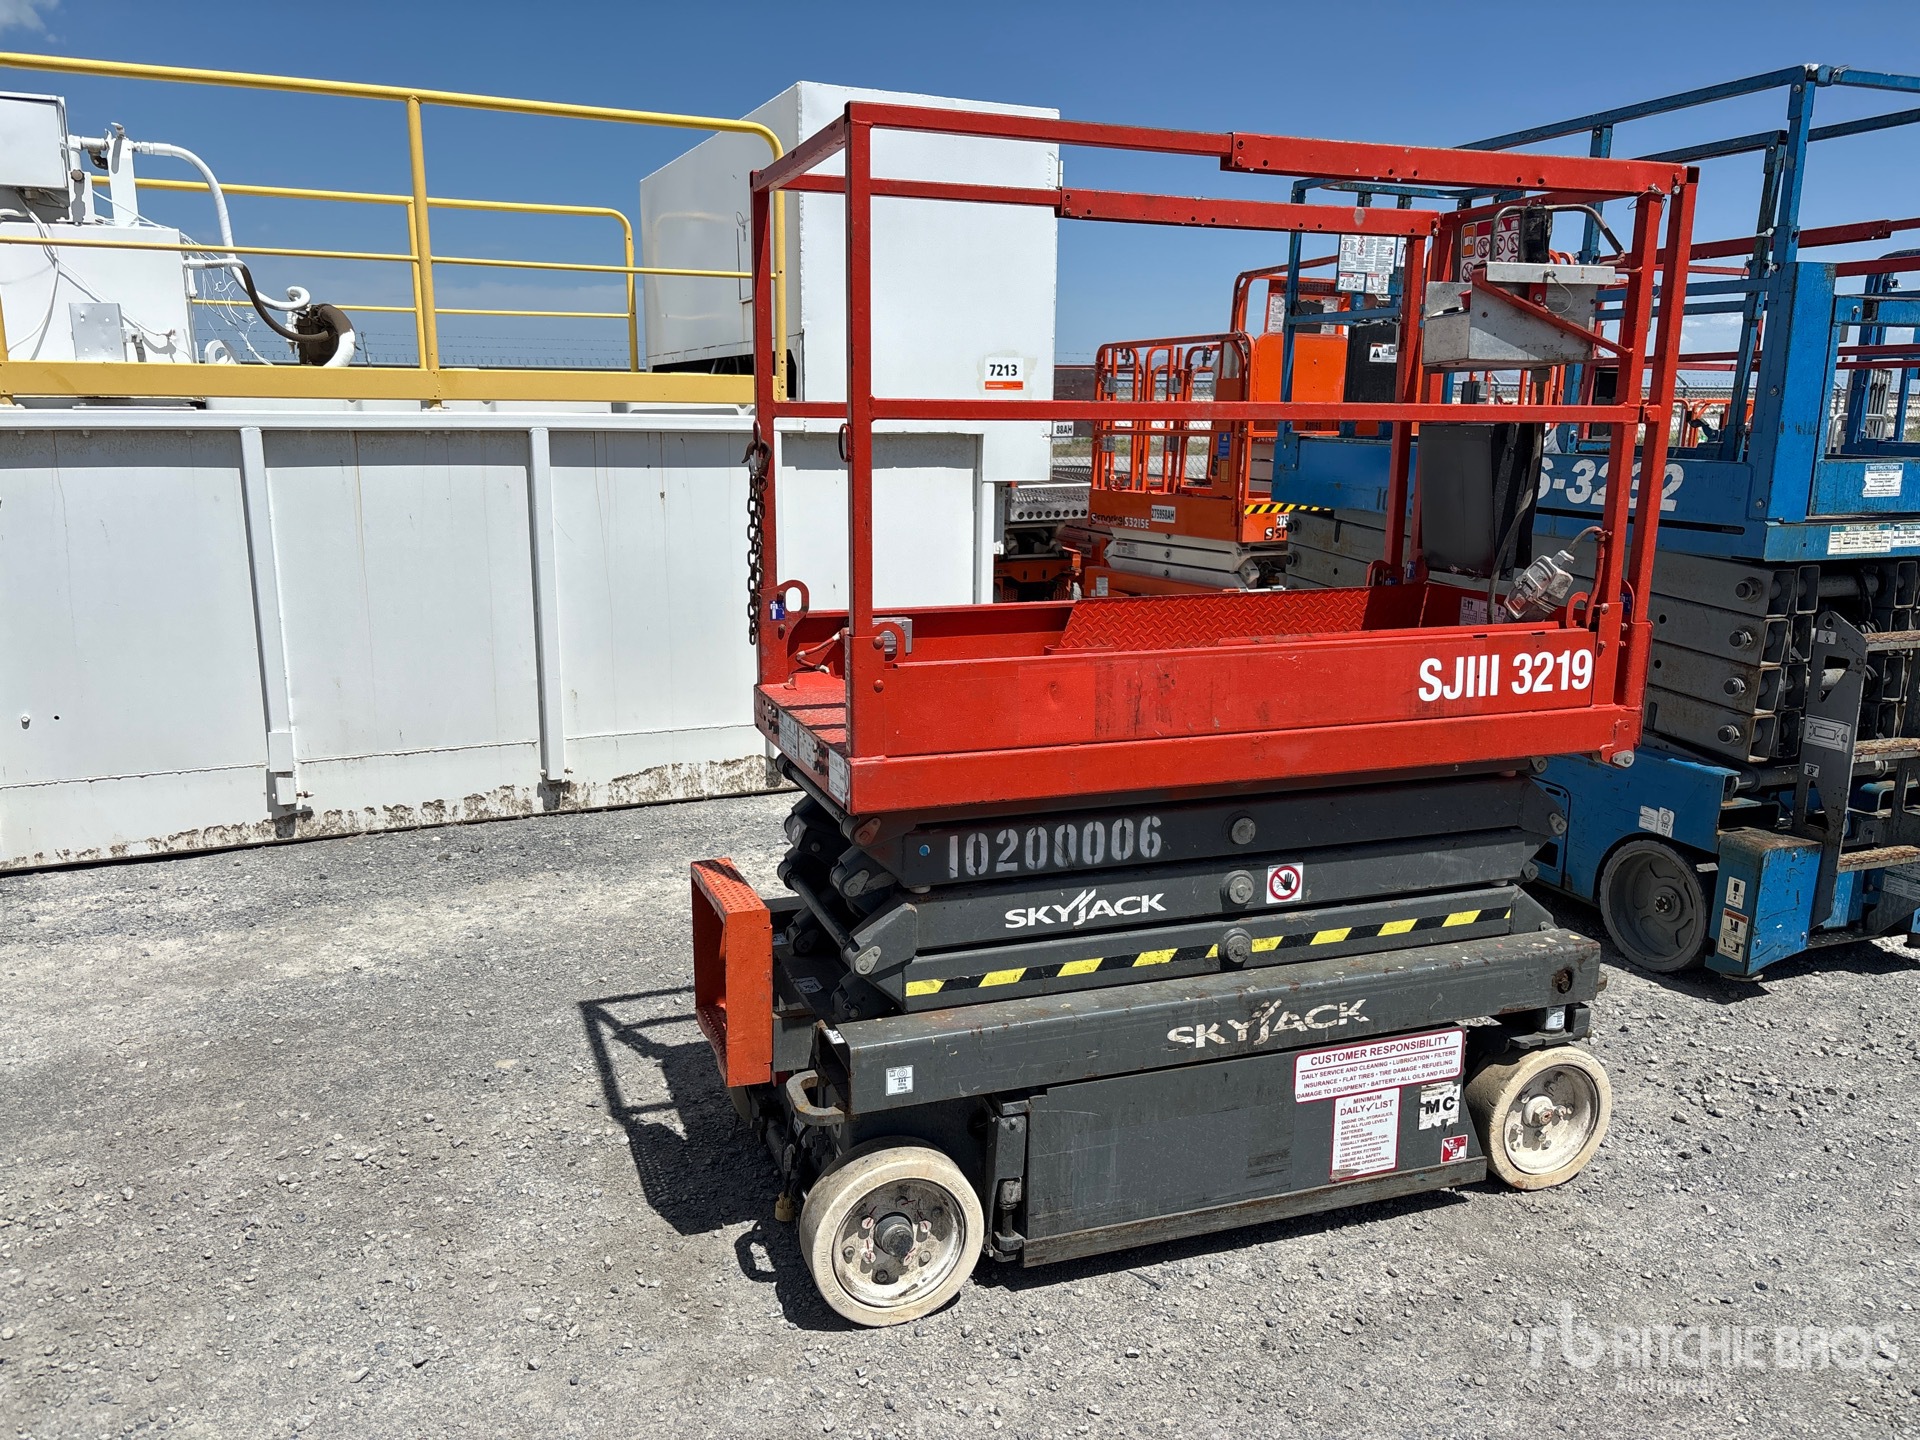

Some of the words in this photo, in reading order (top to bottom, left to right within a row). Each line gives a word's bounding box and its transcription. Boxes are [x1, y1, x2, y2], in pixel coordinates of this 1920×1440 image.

[989, 364, 1018, 377] 7213
[1511, 648, 1593, 695] 3219
[949, 815, 1162, 878] 10200006
[1005, 888, 1167, 929] SKYJACK
[1166, 998, 1371, 1048] SKYJACK
[1302, 1072, 1318, 1080] DAILY
[1320, 1068, 1345, 1078] SERVICE
[1359, 1060, 1388, 1071] CLEANING
[1392, 1053, 1430, 1066] LUBRICATION
[1434, 1050, 1456, 1058] FILTERS
[1310, 1049, 1367, 1066] CUSTOMER
[1370, 1036, 1449, 1056] RESPONSIBILITY
[1296, 1090, 1323, 1099] DAMAGE
[1332, 1083, 1366, 1093] EQUIPMENT
[1370, 1078, 1396, 1086] BATTERY
[1439, 1067, 1458, 1076] FLUIDS
[1304, 1078, 1338, 1089] INSURANCE
[1393, 1066, 1418, 1074] DAMAGE
[1422, 1060, 1453, 1069] REFUELING
[1340, 1104, 1366, 1116] DAILY
[1374, 1100, 1394, 1110] LIST
[1353, 1094, 1382, 1104] MINIMUM
